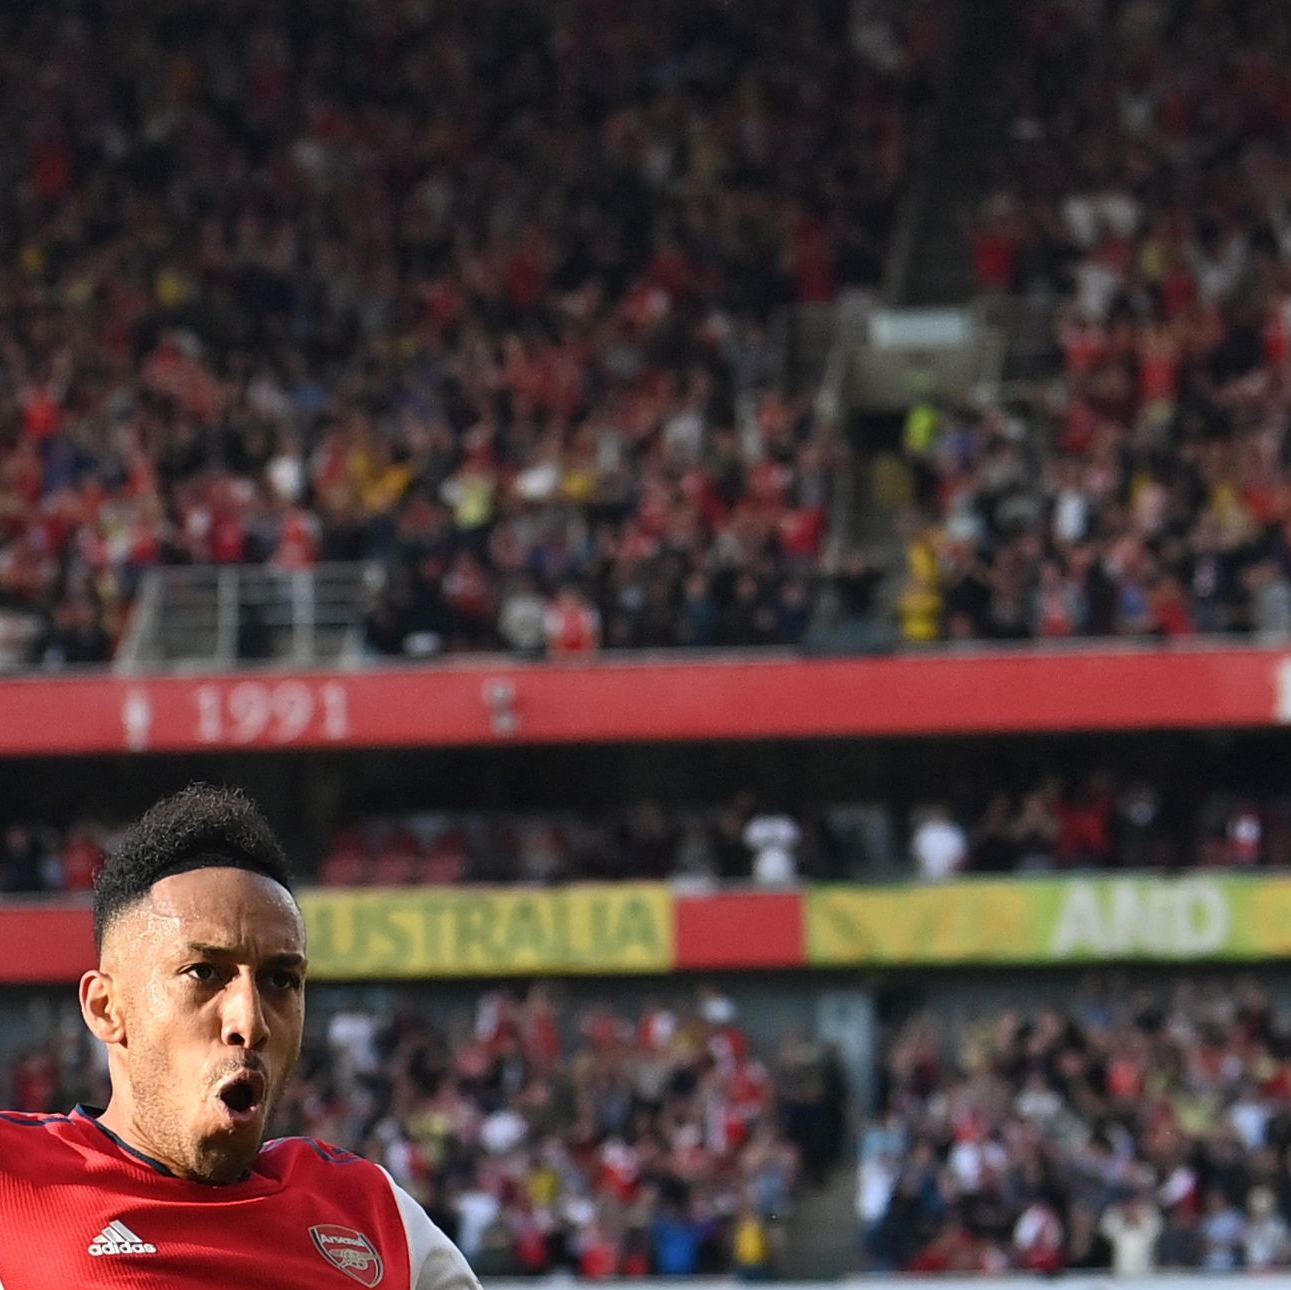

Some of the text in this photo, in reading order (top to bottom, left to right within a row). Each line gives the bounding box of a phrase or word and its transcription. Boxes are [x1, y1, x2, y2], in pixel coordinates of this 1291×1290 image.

[193, 680, 349, 744] 1991
[311, 892, 663, 970] USTRALIA
[1051, 876, 1230, 958] AND
[88, 1241, 157, 1256] adidas
